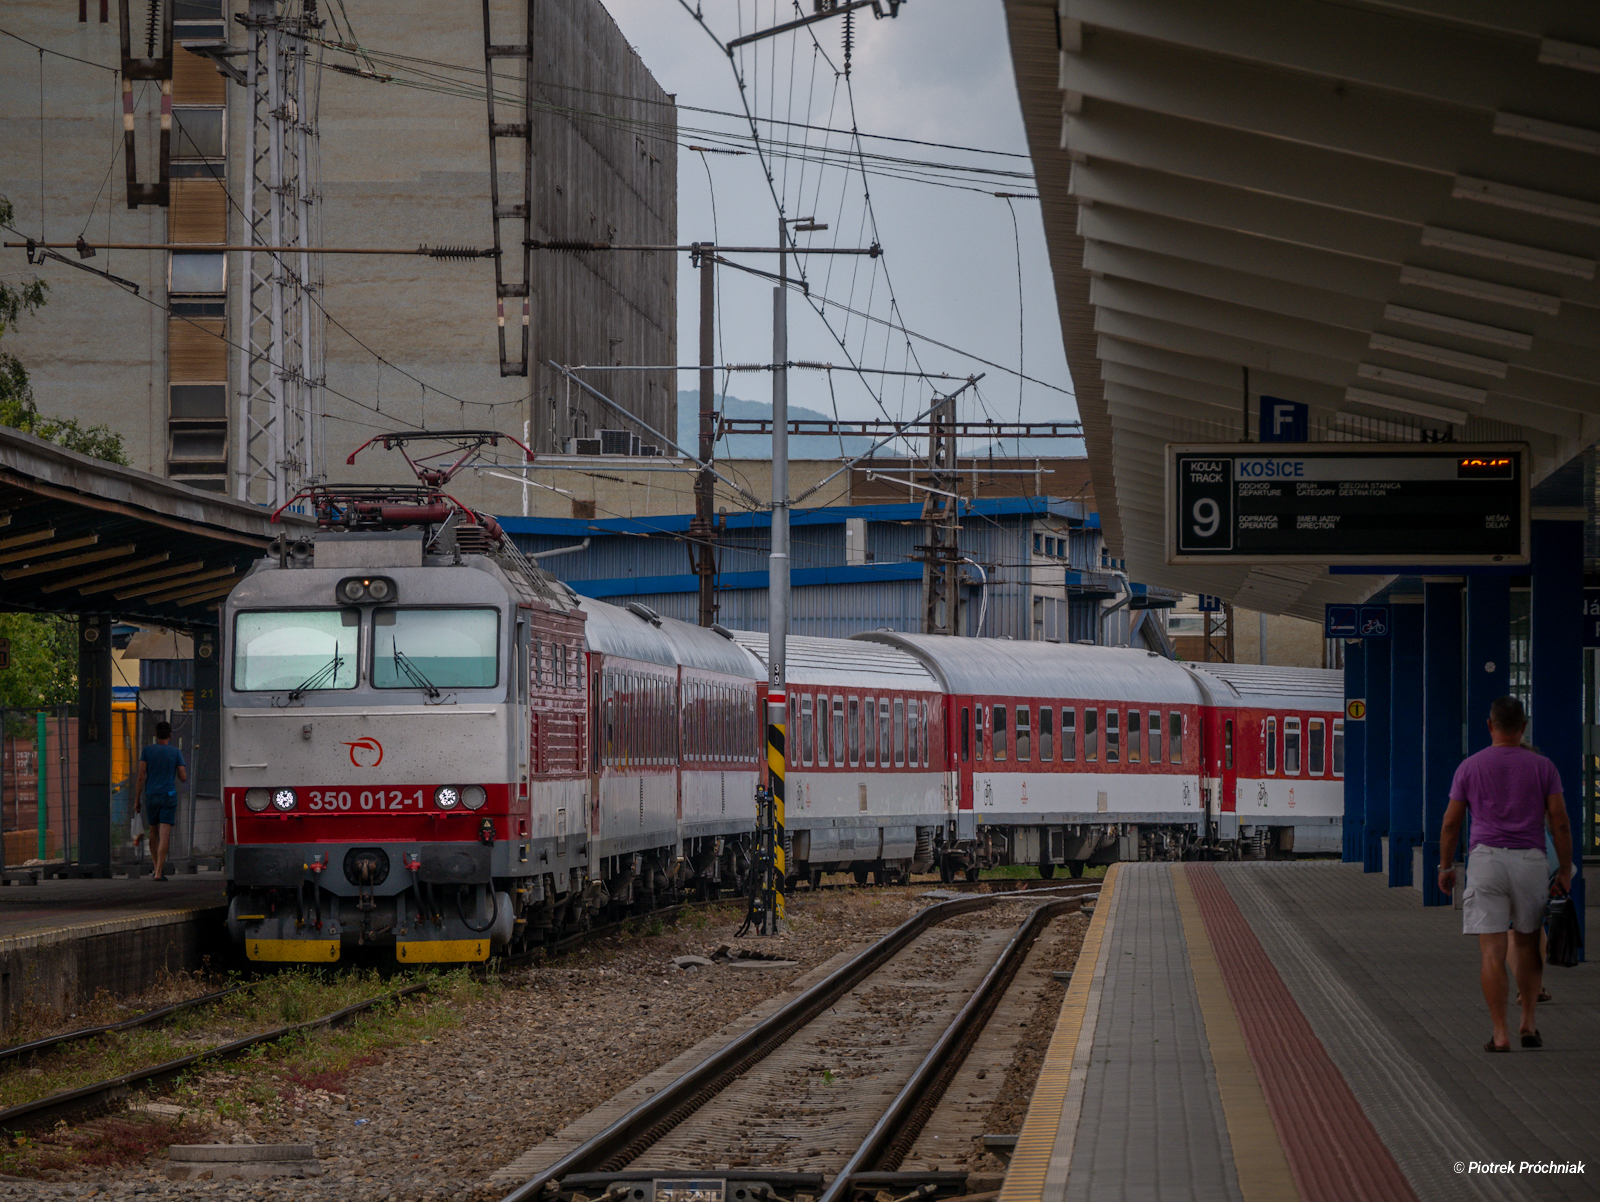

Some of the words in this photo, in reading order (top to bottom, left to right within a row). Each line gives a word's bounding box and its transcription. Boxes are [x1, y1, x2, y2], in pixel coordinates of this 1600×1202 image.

[1273, 404, 1295, 435] F
[1240, 459, 1304, 477] KOŠICE
[1189, 472, 1224, 483] TRACK
[1238, 482, 1270, 490] ODCHOD
[1296, 482, 1318, 490] DRUH
[1370, 482, 1402, 490] STANICA
[1238, 489, 1282, 497] DEPARTURE
[1296, 489, 1337, 497] CATEGORY
[1338, 489, 1387, 497] DESTINATION
[1192, 497, 1221, 538] 9
[1238, 522, 1279, 530] OPERATOR
[1296, 522, 1336, 530] DIRECTION
[1485, 521, 1509, 529] DELAY
[1203, 594, 1216, 608] H
[774, 663, 780, 685] 39
[86, 677, 102, 688] 20
[200, 688, 213, 699] 21
[984, 705, 990, 729] 2
[1183, 713, 1188, 735] 2
[1259, 718, 1266, 738] 2
[308, 790, 352, 810] 350
[359, 789, 424, 810] 012-1
